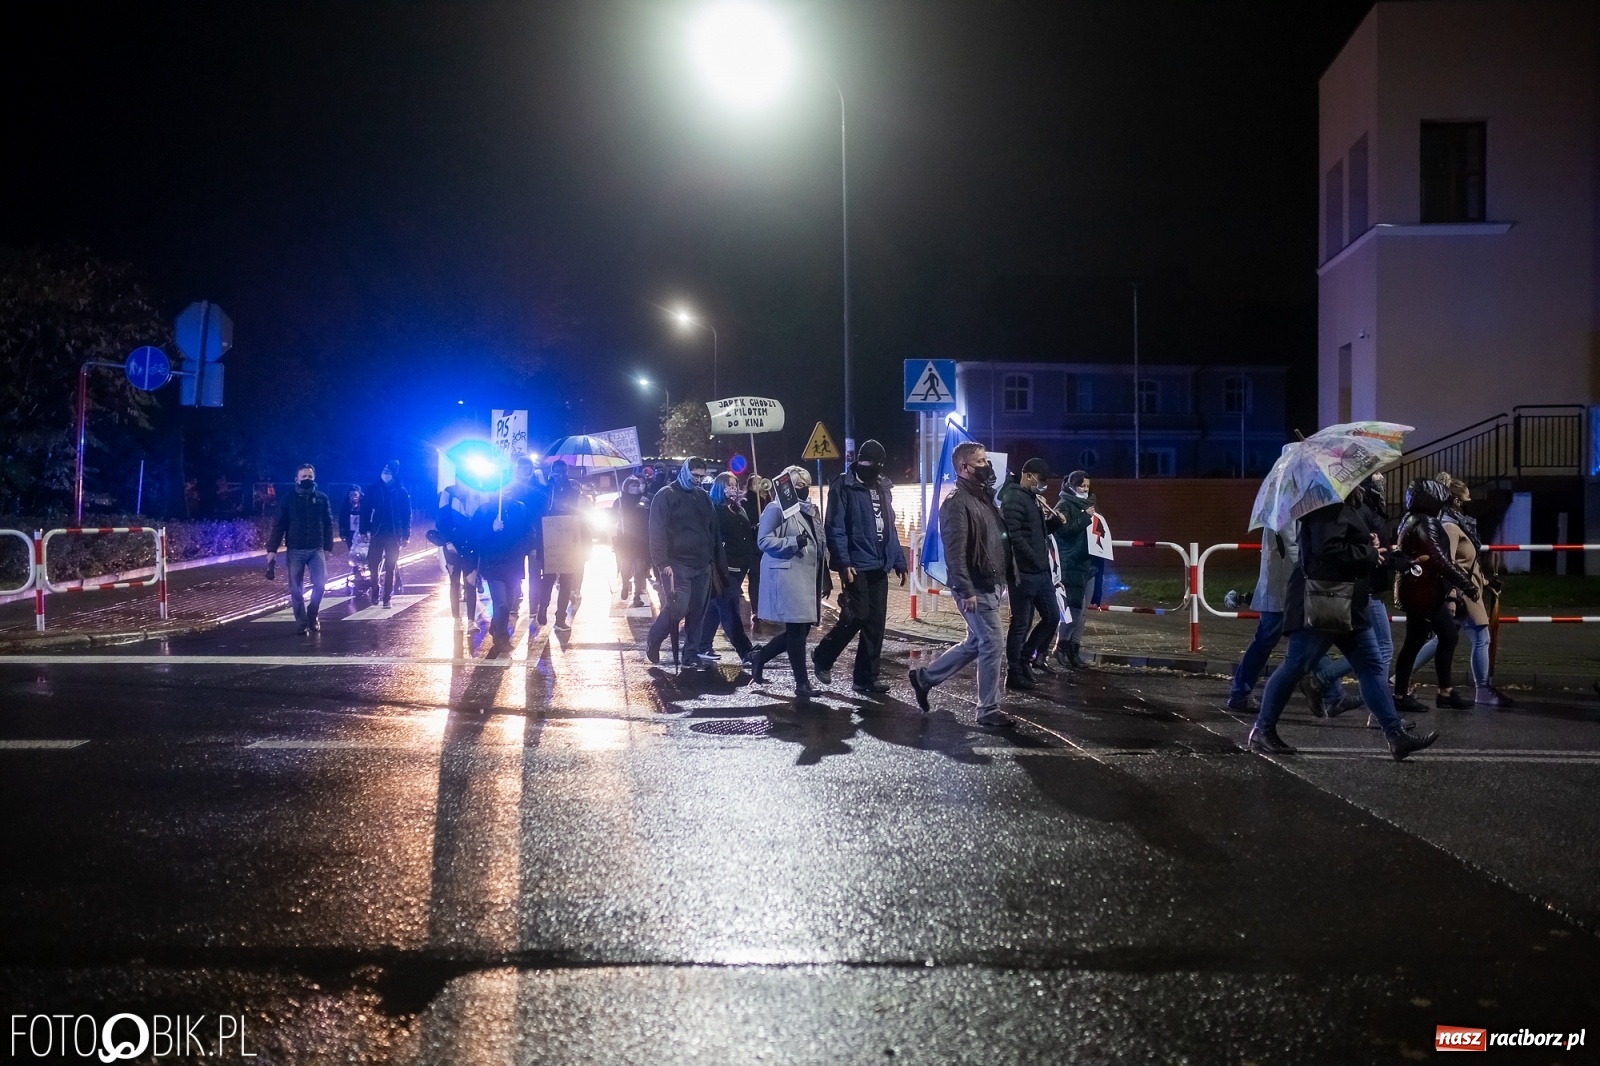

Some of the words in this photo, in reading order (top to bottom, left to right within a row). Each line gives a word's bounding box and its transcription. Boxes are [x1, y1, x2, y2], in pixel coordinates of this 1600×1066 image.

[718, 399, 746, 408] JAREK
[750, 399, 776, 407] CHODZI
[734, 407, 768, 416] PILOTEM
[497, 417, 510, 438] PIS
[728, 420, 739, 428] DO
[745, 418, 764, 427] KINA
